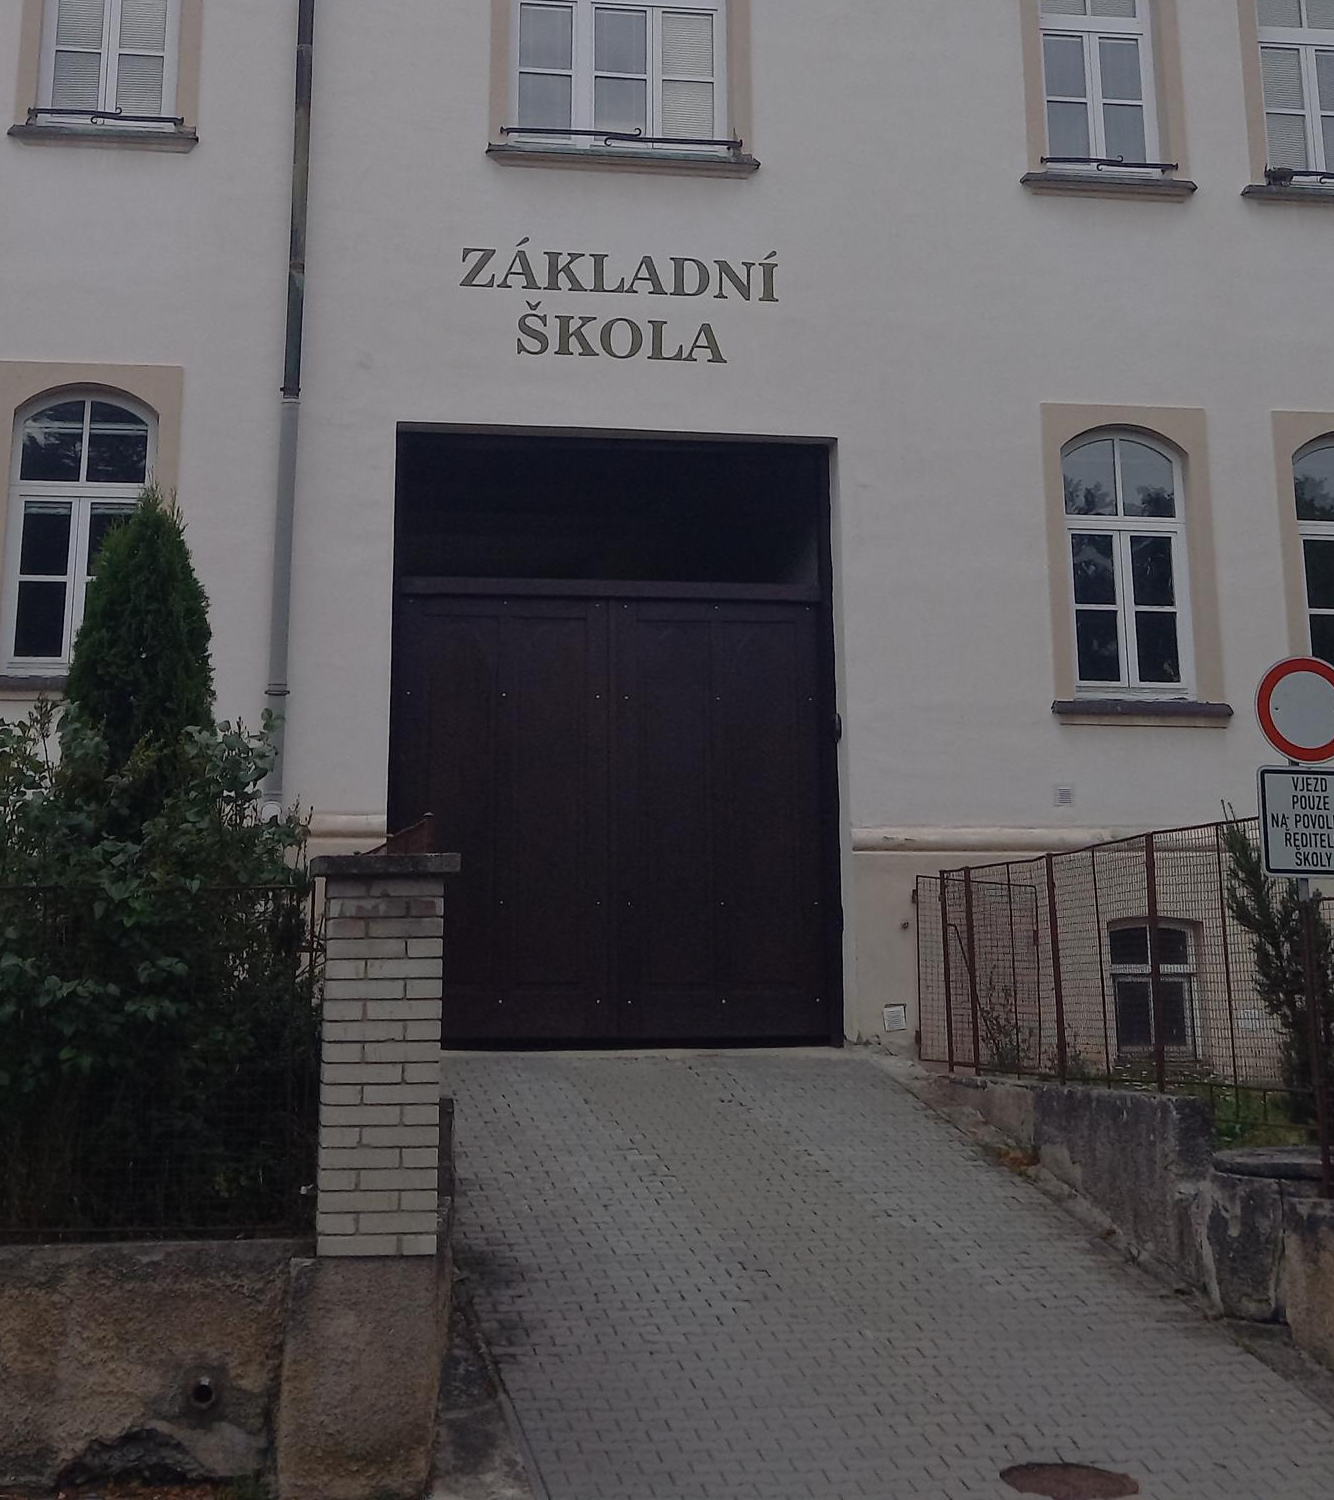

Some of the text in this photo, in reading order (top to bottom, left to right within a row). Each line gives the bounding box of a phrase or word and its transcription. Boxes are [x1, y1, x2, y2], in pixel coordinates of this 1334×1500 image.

[459, 236, 779, 302] ZÁKLADNÍ
[517, 300, 728, 363] ŠKOLA
[1291, 776, 1328, 792] VJEZD
[1292, 795, 1330, 811] POUZE
[1271, 813, 1289, 828] NA
[1295, 846, 1333, 867] ŠKOLY
